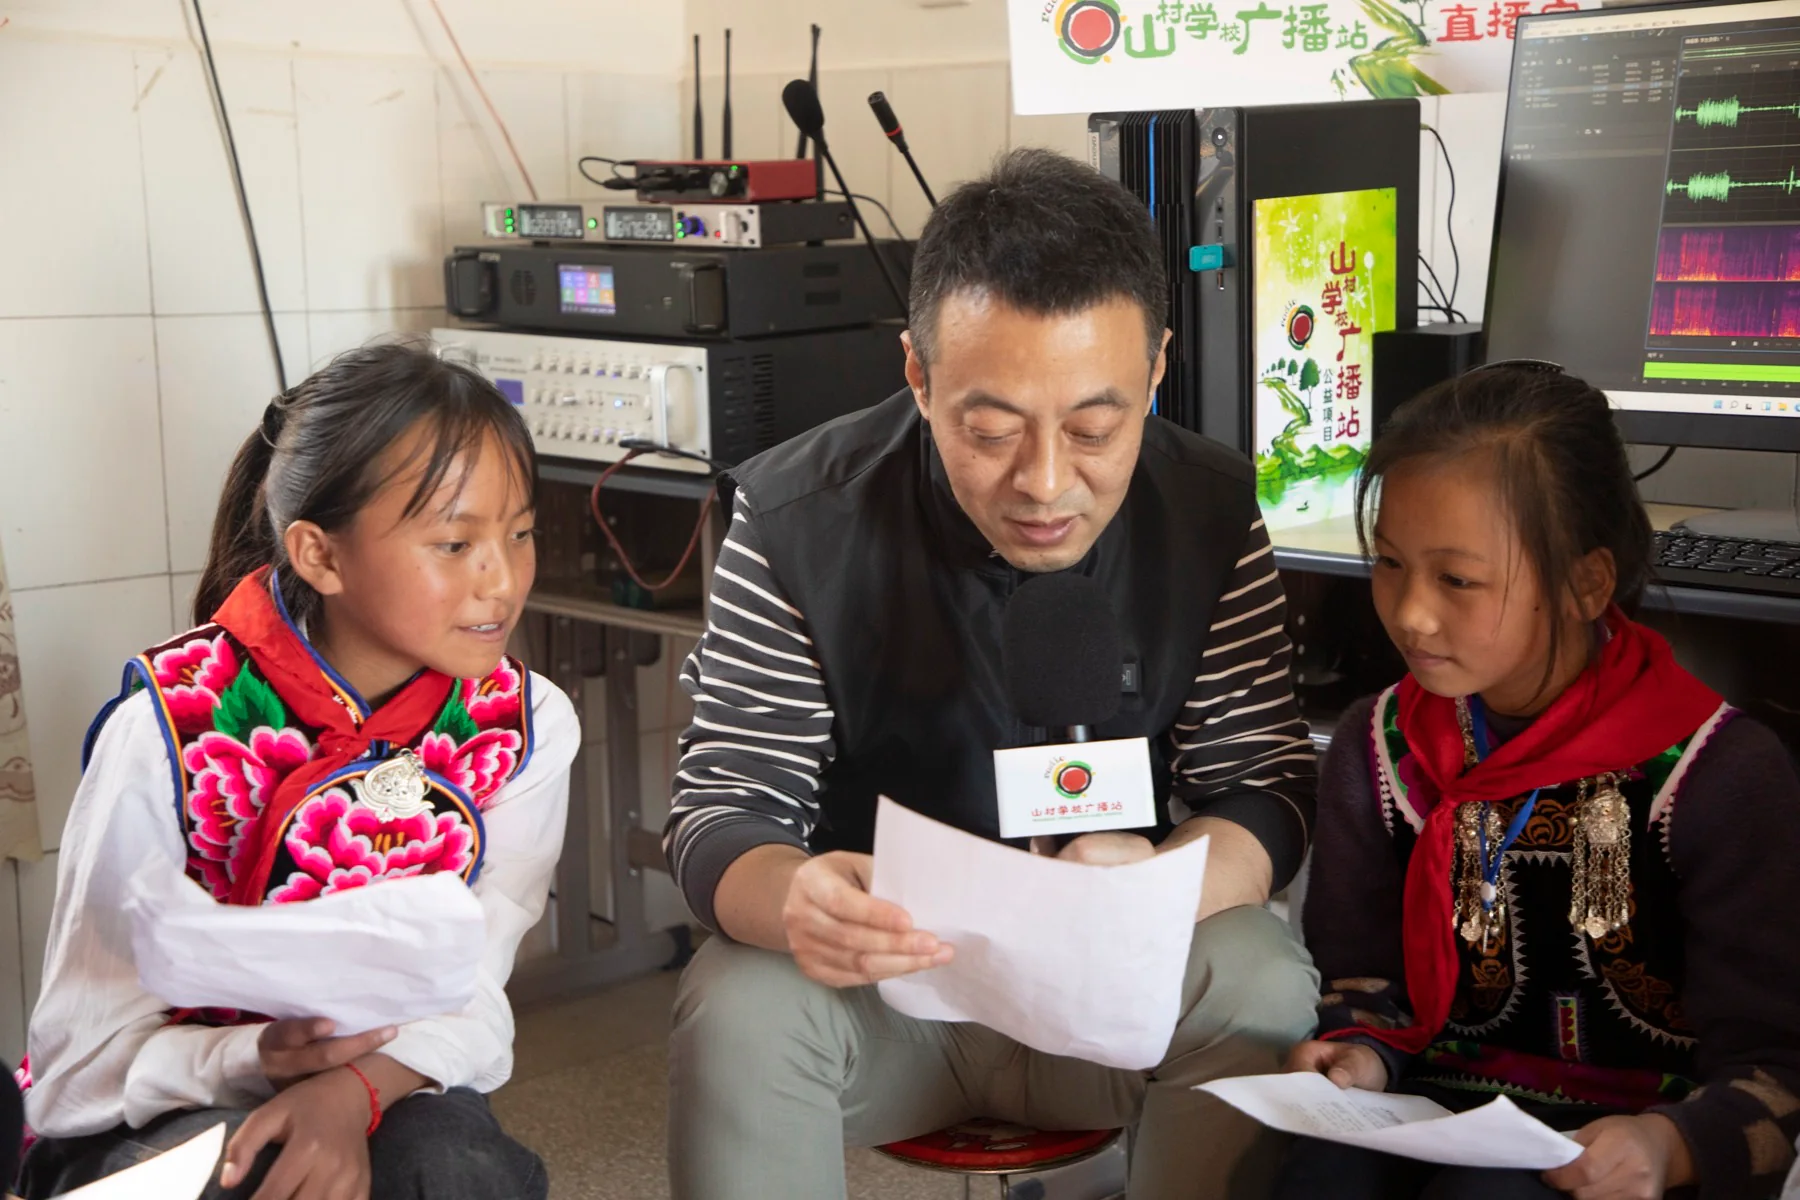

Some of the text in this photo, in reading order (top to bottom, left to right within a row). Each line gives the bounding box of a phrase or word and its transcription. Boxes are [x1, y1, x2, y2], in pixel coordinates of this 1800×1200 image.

[1123, 0, 1368, 58] 山村学校广播站
[1321, 241, 1363, 439] 山村学校广播站
[1323, 368, 1333, 442] 公益项目
